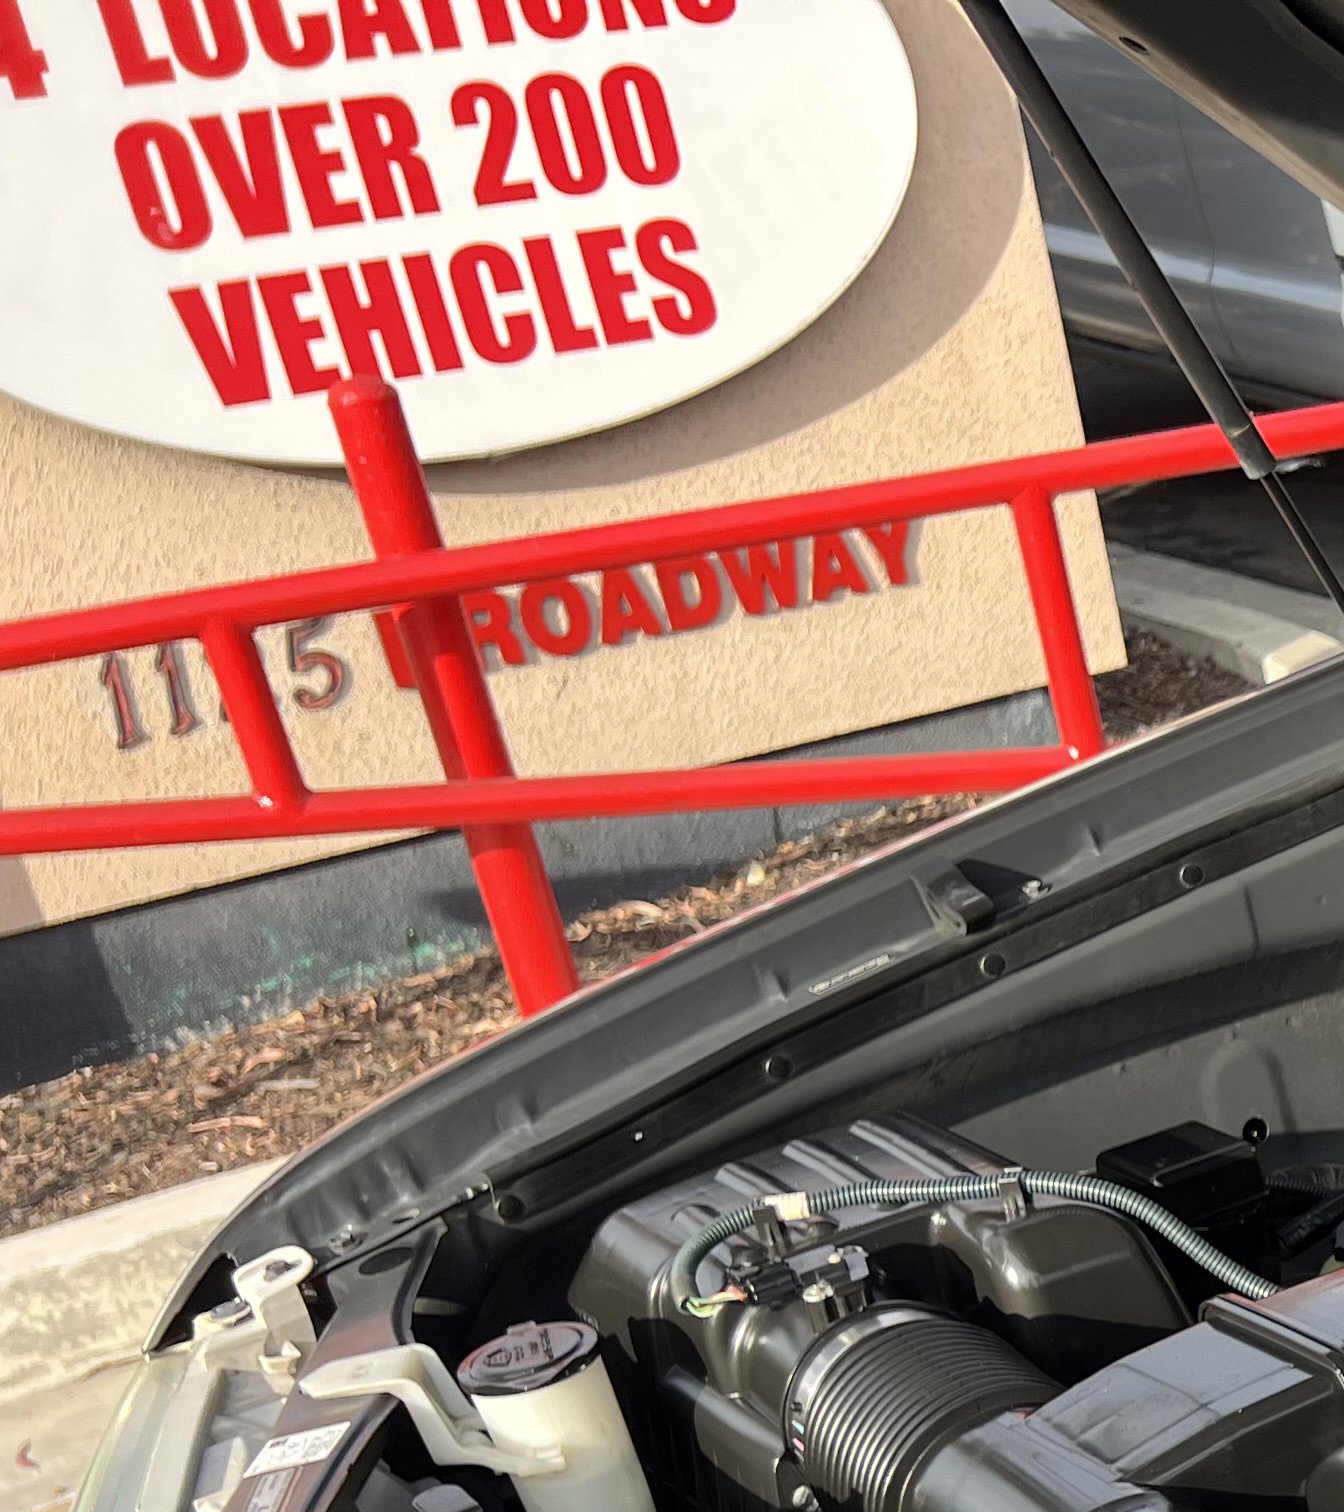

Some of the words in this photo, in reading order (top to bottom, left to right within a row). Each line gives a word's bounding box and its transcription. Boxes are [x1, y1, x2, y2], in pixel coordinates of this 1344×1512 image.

[113, 94, 441, 252] OVER
[449, 63, 681, 206] 200
[170, 216, 718, 408] VEHICLES
[101, 616, 346, 750] 115
